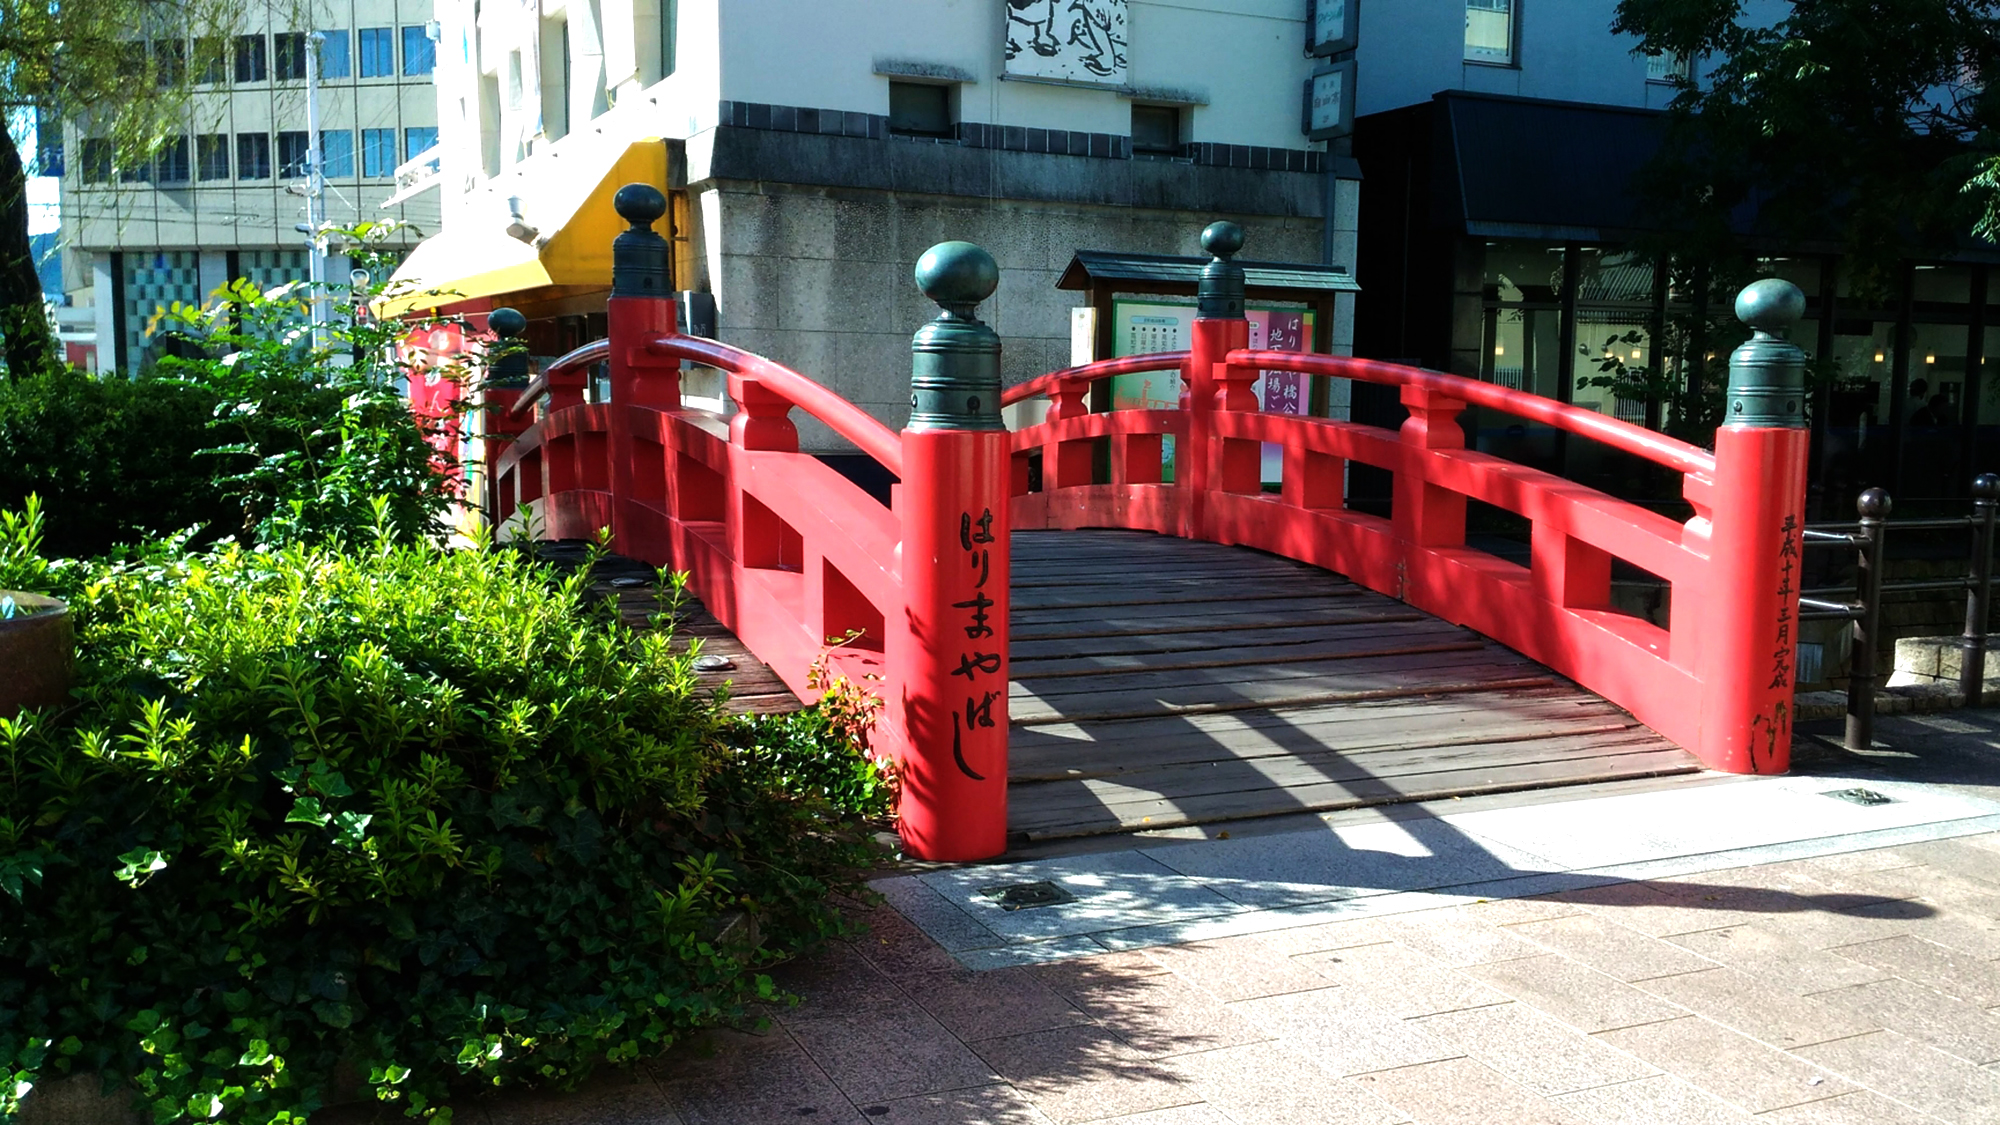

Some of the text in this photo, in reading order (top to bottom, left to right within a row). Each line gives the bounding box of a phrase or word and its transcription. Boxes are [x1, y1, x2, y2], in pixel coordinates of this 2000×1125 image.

[950, 508, 1001, 781] はりまやばし
[1768, 515, 1798, 690] 平成十年三月完成
